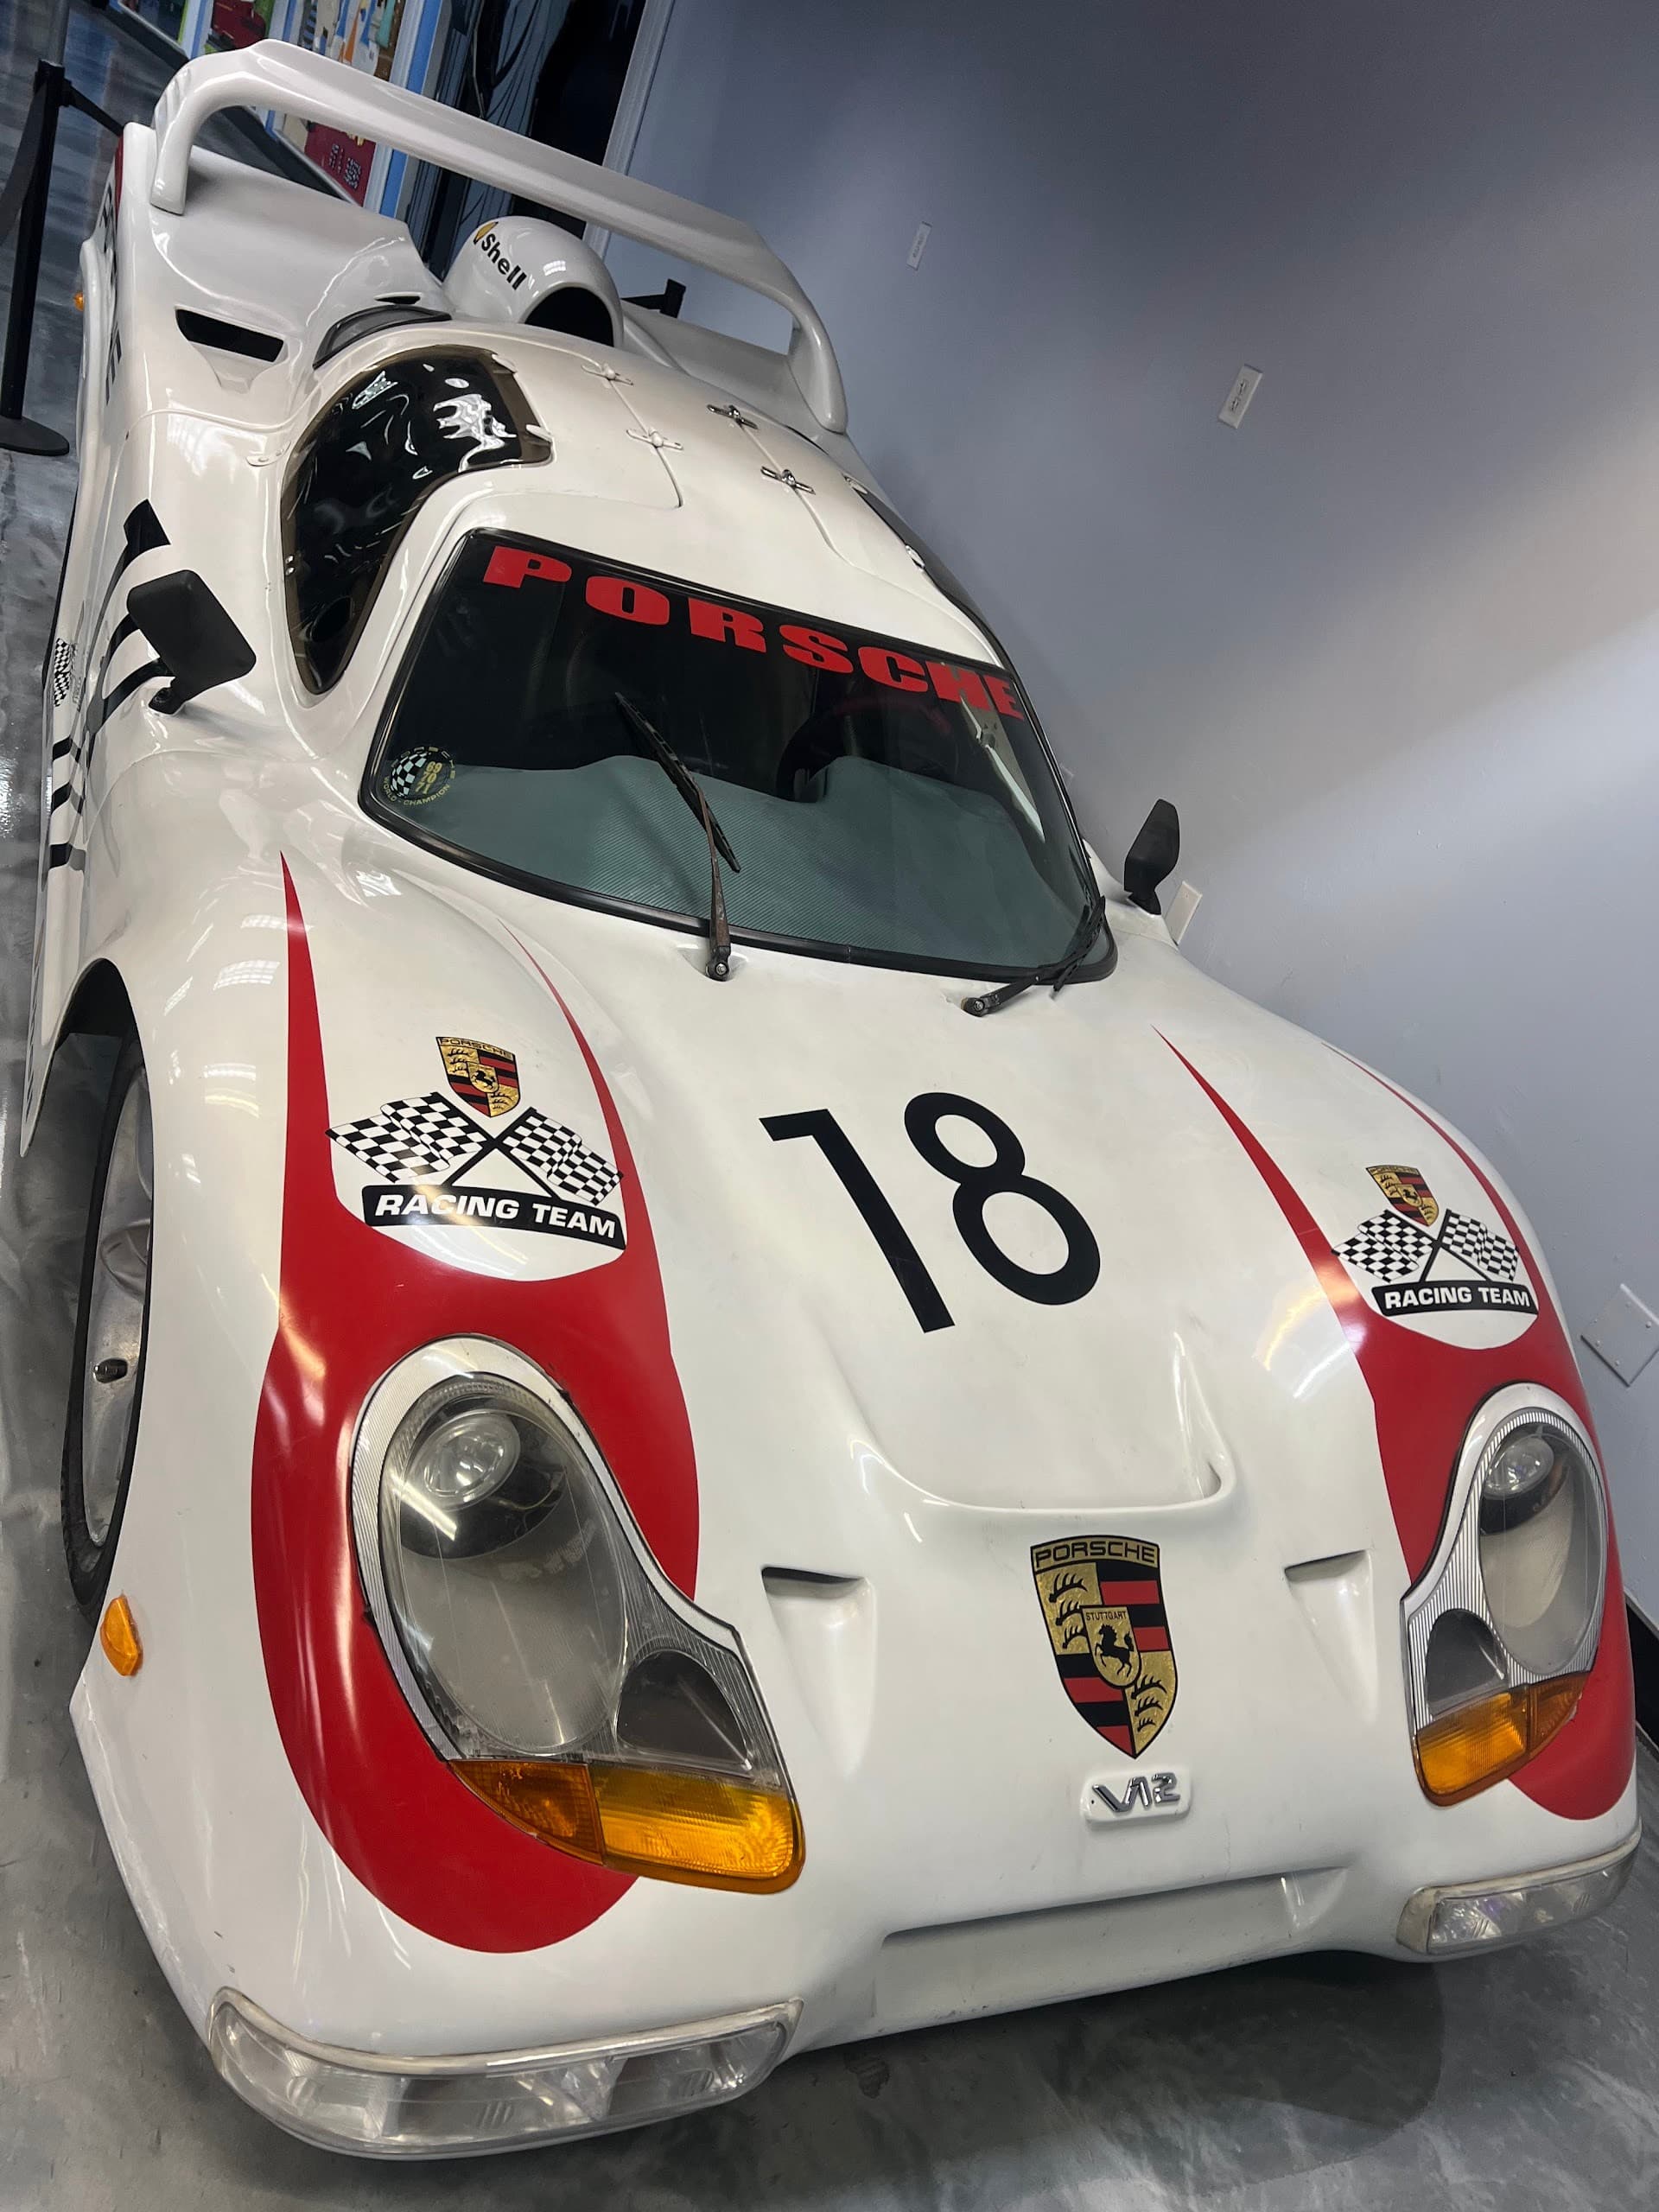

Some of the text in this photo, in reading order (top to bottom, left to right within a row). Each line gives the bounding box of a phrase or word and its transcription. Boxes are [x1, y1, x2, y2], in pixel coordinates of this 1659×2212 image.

[481, 233, 527, 290] Shell
[482, 545, 1025, 721] PORSCHE
[421, 772, 437, 784] 70
[426, 761, 442, 773] 69
[404, 784, 451, 805] CHAMPION
[416, 782, 430, 794] 71
[440, 1038, 513, 1059] PORSCHE
[374, 1194, 616, 1239] RACING TEAM
[759, 1092, 1101, 1333] 18
[1384, 1287, 1530, 1309] RACING TEAM
[1035, 1541, 1155, 1568] PORSCHE
[1085, 1611, 1127, 1622] STUTTGART
[1092, 1772, 1181, 1813] V12
